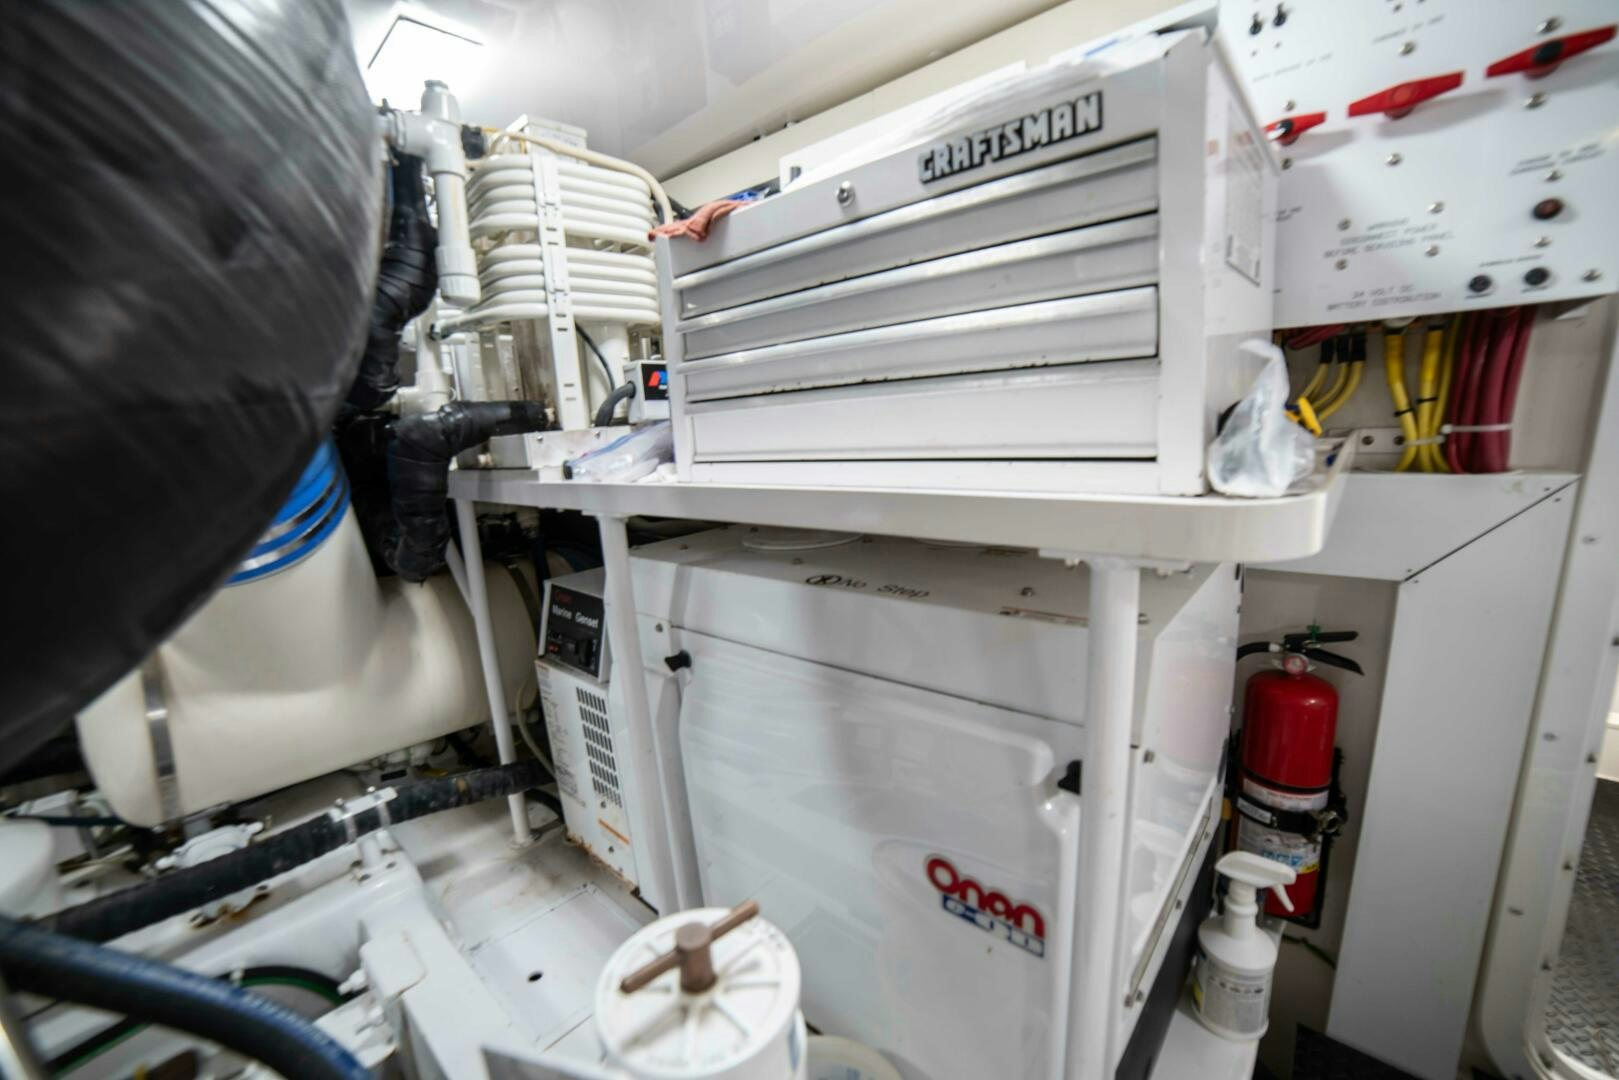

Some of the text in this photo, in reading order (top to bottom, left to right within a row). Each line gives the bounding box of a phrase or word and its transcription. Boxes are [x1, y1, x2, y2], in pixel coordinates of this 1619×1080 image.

[918, 89, 1103, 184] CRAFTSMAN
[1404, 222, 1438, 234] POWER
[1370, 286, 1396, 297] VOLT
[1326, 292, 1442, 311] BATTERY DISTRIBUTION
[877, 583, 930, 599] Step
[552, 603, 599, 629] Marine Genset
[927, 858, 1045, 940] Onan
